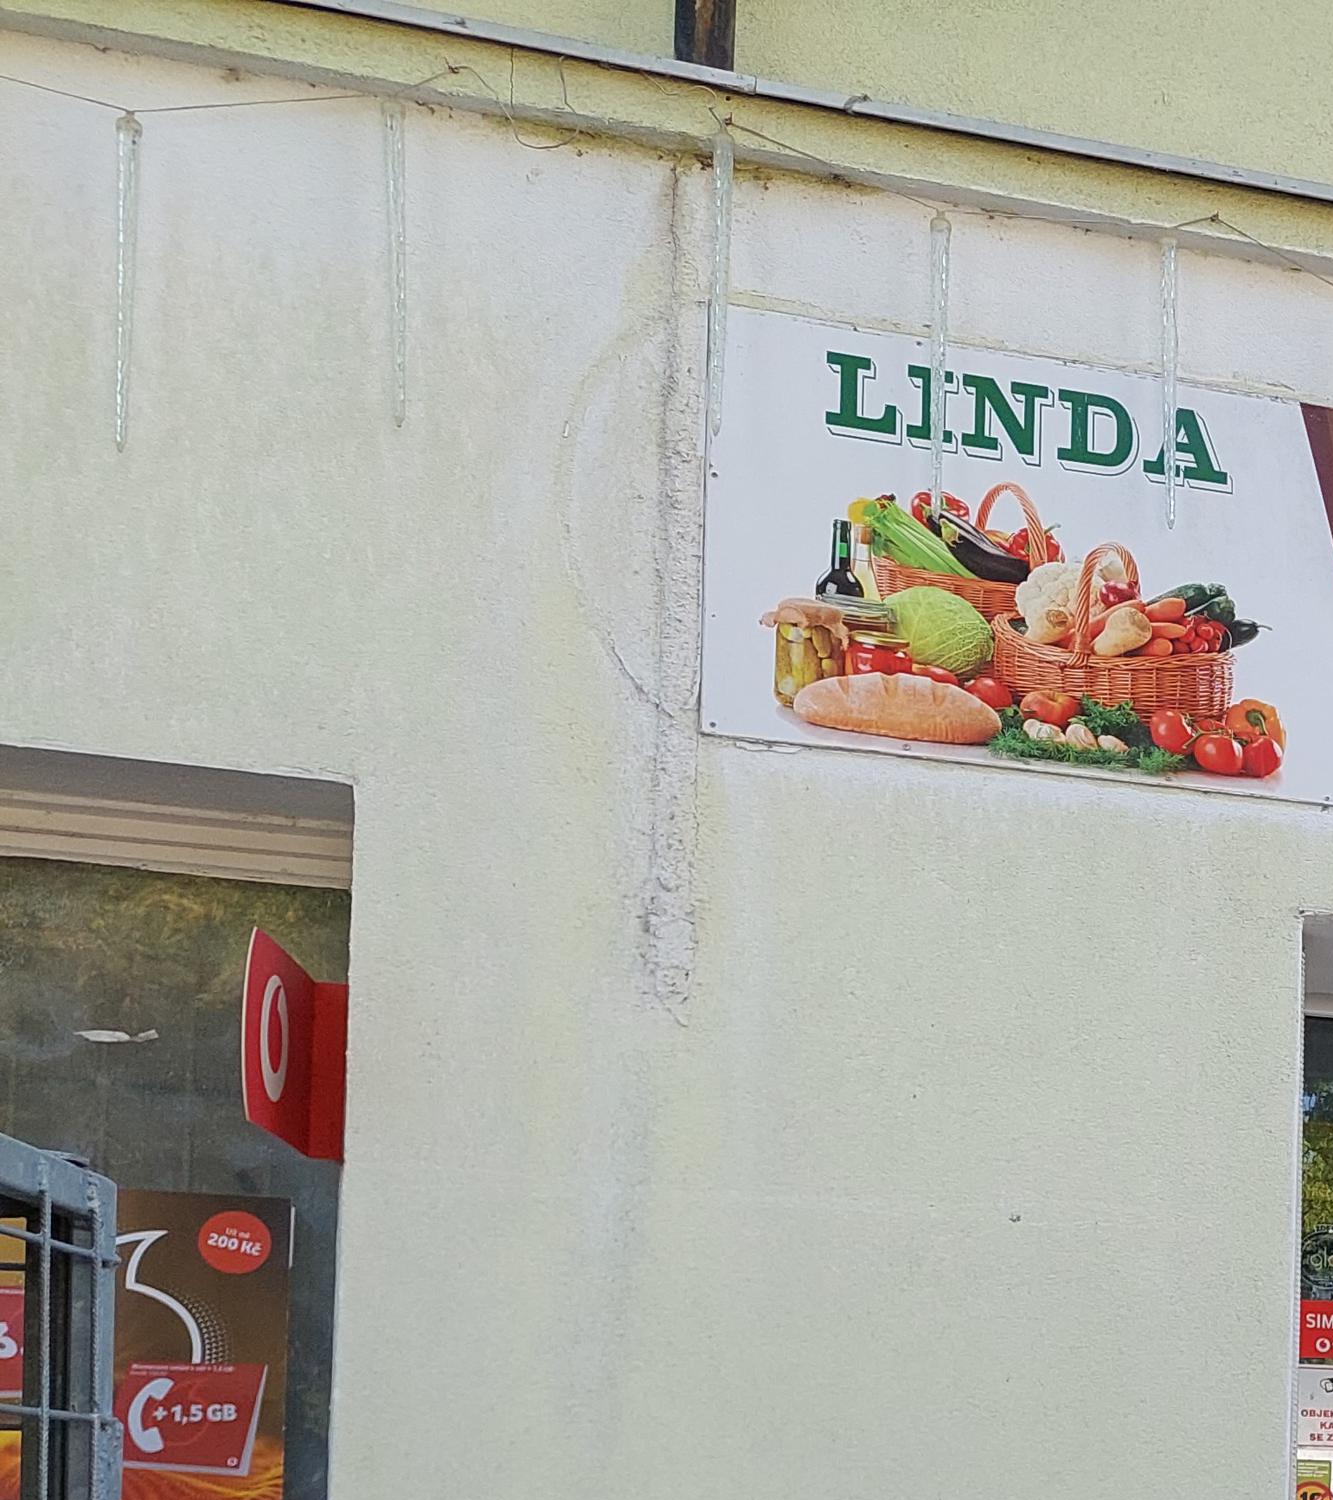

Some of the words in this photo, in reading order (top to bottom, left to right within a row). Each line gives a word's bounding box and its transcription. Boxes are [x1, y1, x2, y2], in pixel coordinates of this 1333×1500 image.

[825, 351, 1231, 492] LINDA
[207, 1232, 239, 1251] 200
[241, 1240, 262, 1256] Kč
[171, 1404, 203, 1426] 1,5
[207, 1404, 238, 1422] GB
[1310, 1433, 1324, 1441] SE
